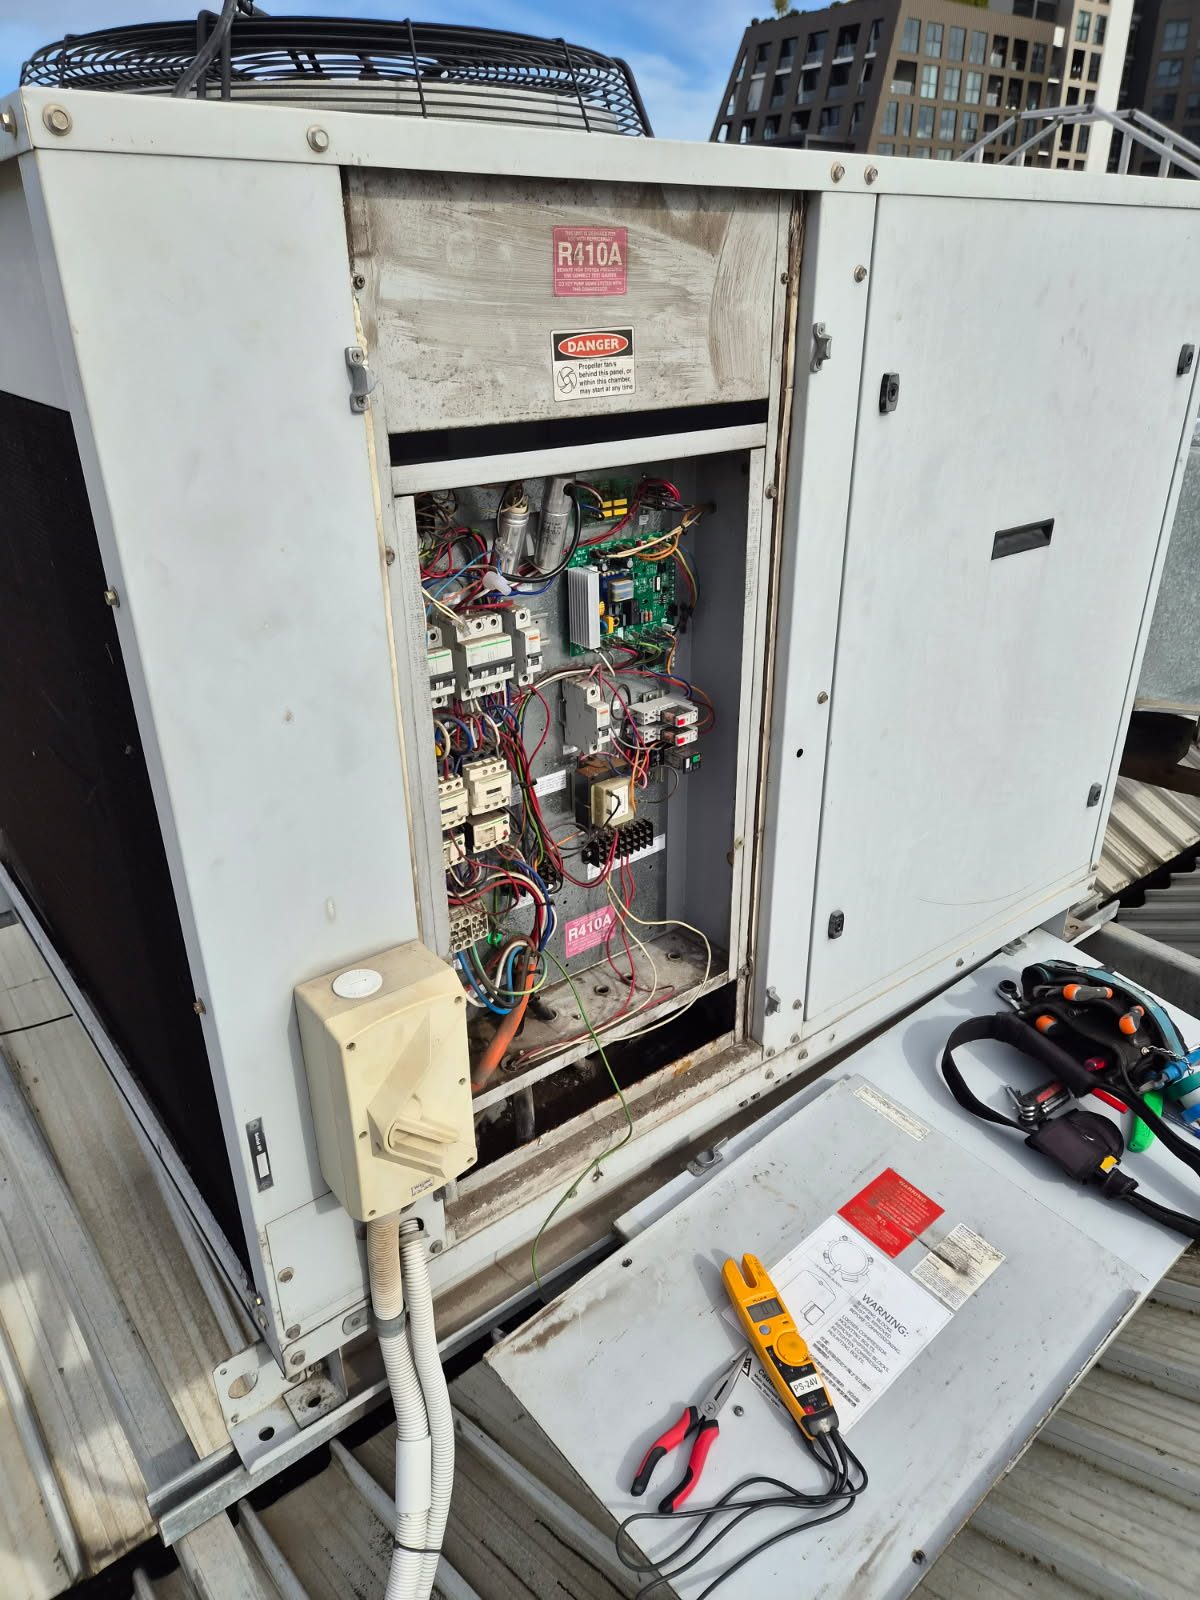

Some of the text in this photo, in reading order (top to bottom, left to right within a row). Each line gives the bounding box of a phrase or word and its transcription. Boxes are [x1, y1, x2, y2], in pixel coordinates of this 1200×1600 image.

[558, 242, 622, 266] R410A
[568, 338, 619, 352] DANGER
[568, 913, 611, 942] R410A
[862, 1294, 908, 1336] WARNING:
[794, 1378, 818, 1393] PS-24V
